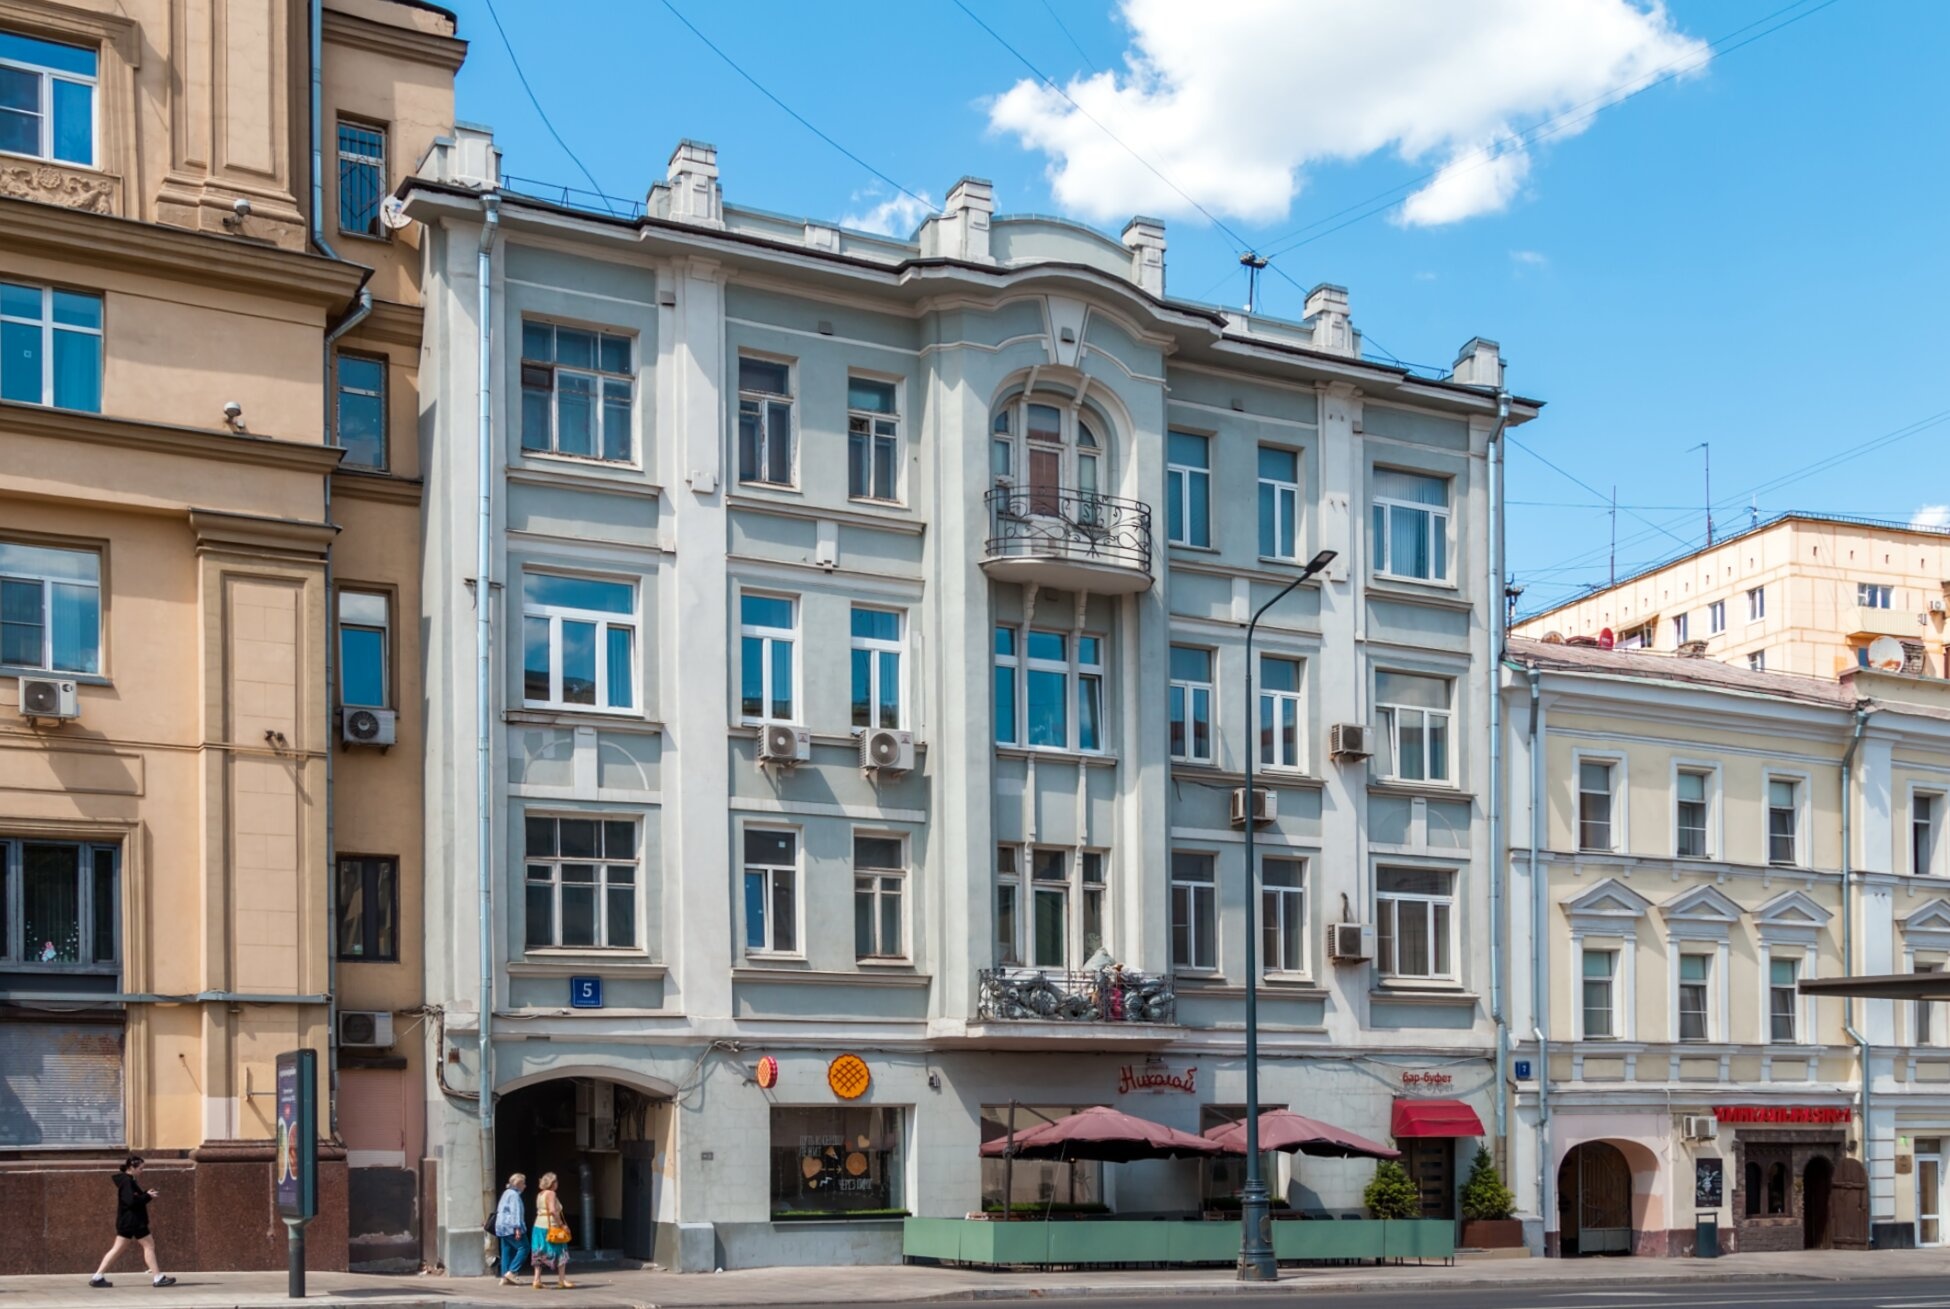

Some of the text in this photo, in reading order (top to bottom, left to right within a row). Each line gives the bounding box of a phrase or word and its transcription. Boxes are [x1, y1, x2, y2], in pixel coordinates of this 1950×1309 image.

[582, 982, 593, 998] 5
[1118, 1063, 1198, 1095] Николай
[1402, 1070, 1453, 1084] бар-буфет
